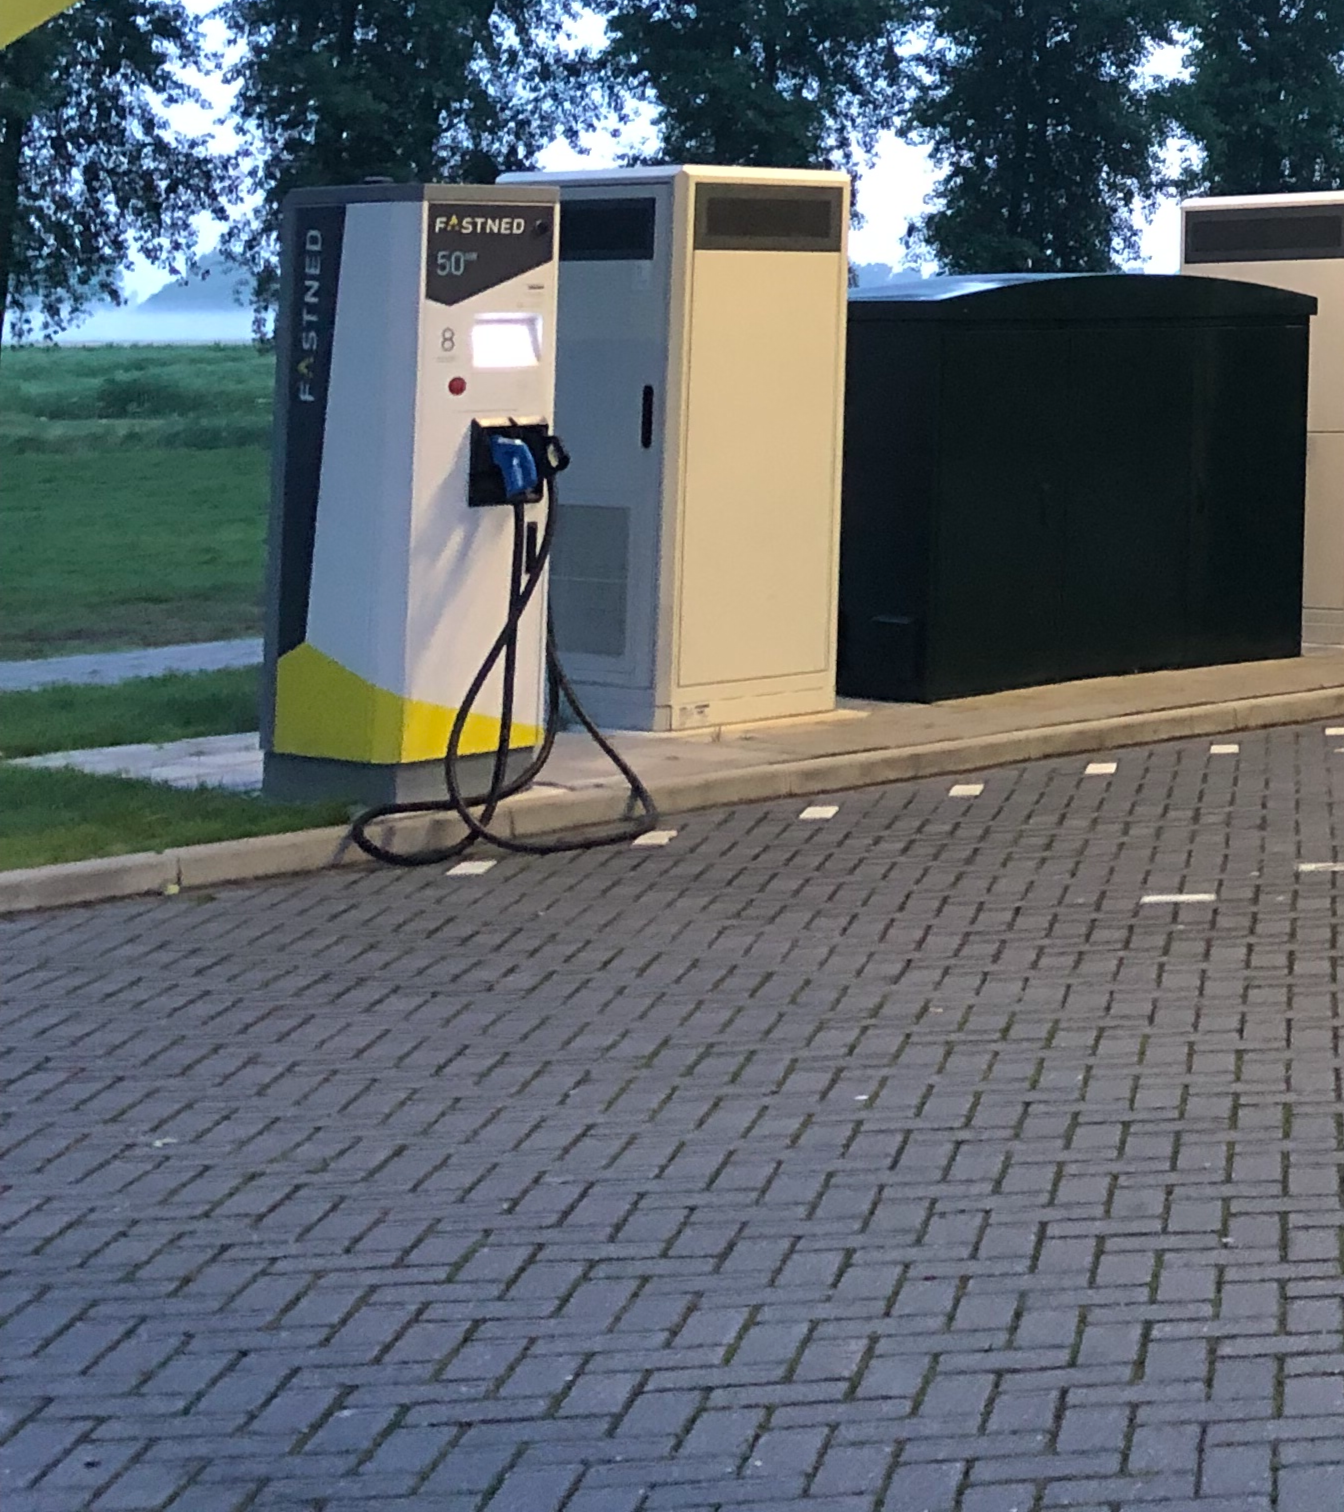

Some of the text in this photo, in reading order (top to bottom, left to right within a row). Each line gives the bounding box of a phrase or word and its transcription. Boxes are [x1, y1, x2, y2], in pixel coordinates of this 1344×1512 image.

[435, 214, 525, 234] FASTNED
[297, 229, 323, 402] FASTNED
[441, 327, 455, 352] 8
